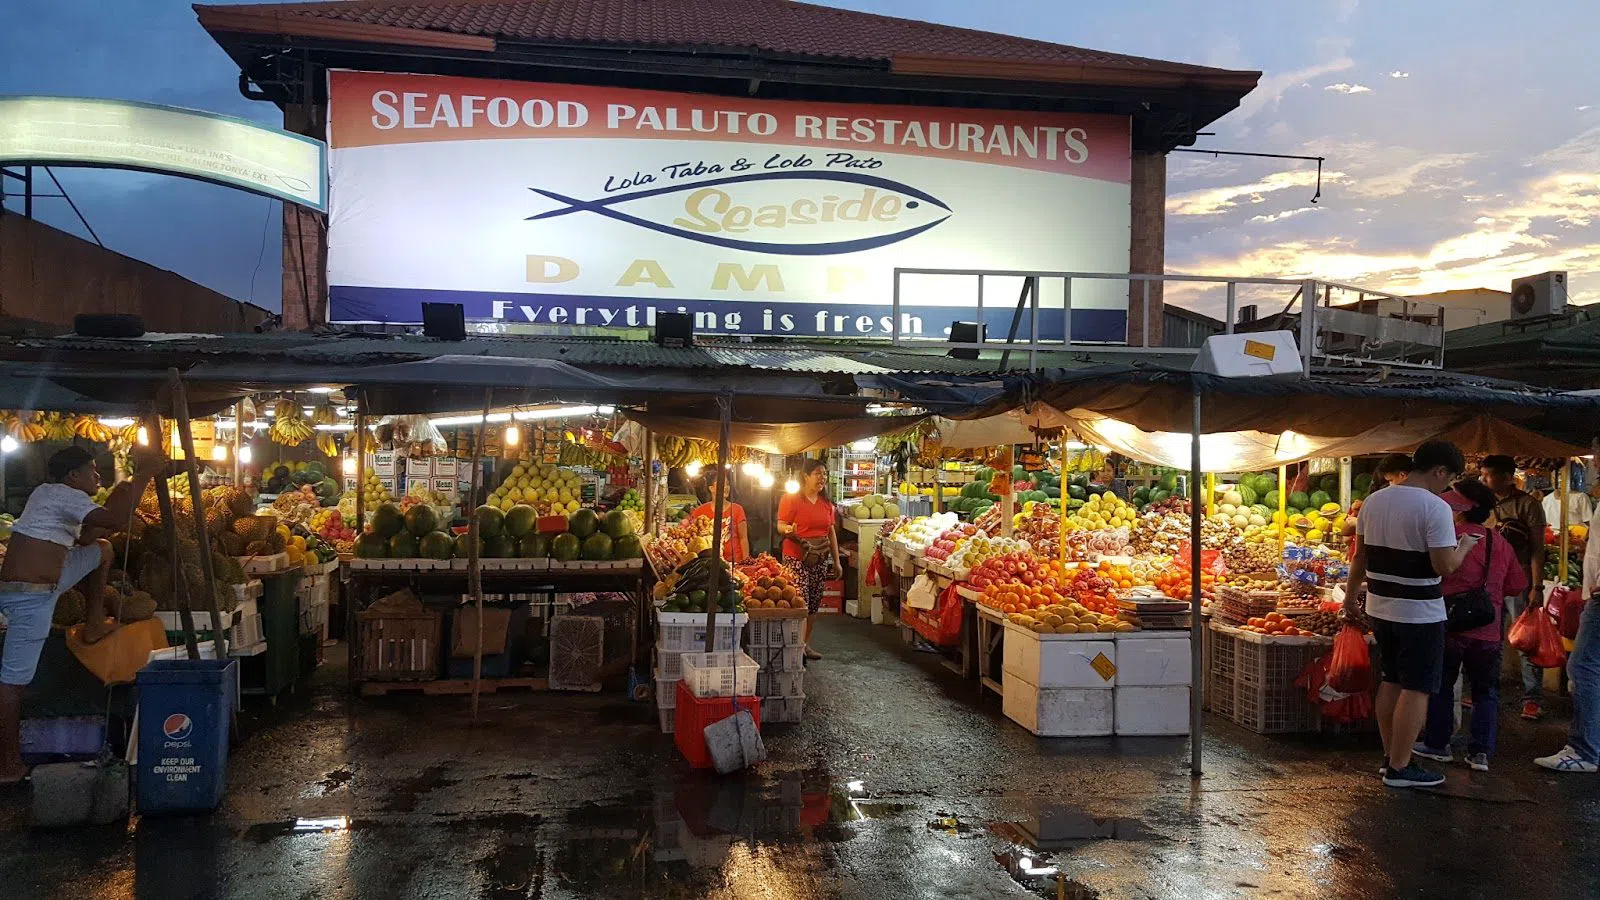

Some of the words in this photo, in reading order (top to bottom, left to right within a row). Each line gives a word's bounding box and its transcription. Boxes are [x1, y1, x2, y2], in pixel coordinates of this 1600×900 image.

[371, 90, 589, 130] SEAFOOD
[607, 104, 778, 136] PALUTO
[795, 115, 1090, 164] RESTAURANTS
[604, 172, 656, 192] Lola
[661, 161, 724, 179] Taba
[730, 158, 755, 171] &
[764, 153, 813, 169] Lolo
[826, 153, 883, 169] Pato
[673, 188, 902, 233] Seaside
[763, 309, 795, 332] is
[815, 310, 923, 334] fresh
[164, 741, 192, 749] pepsi
[153, 765, 201, 774] ENVIRONMENT
[161, 757, 179, 765] KEEP
[180, 757, 195, 765] OUR
[166, 773, 188, 781] CLEAN
